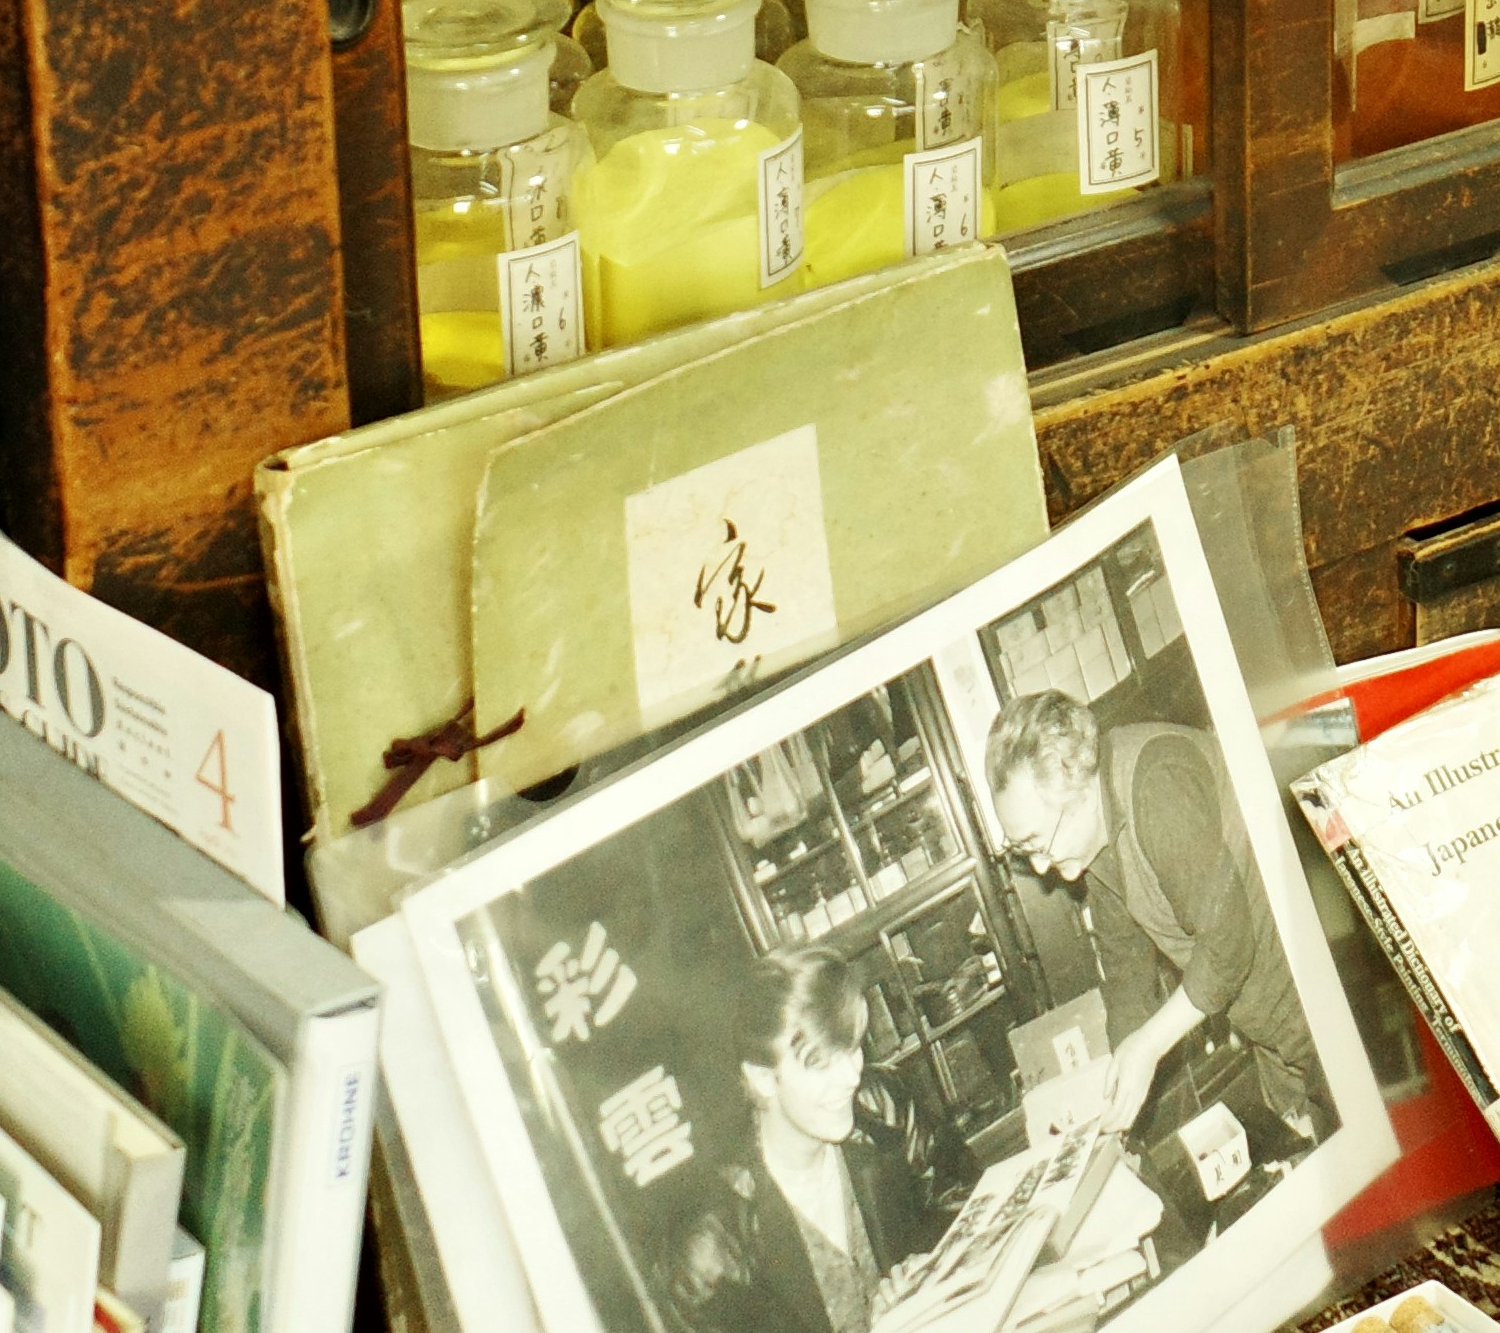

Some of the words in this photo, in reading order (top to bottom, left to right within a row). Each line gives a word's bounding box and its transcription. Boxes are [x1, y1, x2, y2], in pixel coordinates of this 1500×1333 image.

[1133, 128, 1144, 148] 5
[960, 213, 968, 236] 6
[559, 307, 567, 330] 6
[196, 730, 236, 834] 4
[1388, 791, 1422, 813] An
[1347, 845, 1363, 868] An
[1359, 865, 1406, 943] Illustrated
[1401, 937, 1448, 1018] Dictionary
[1442, 1011, 1460, 1033] of
[534, 921, 695, 1188] 彩雲
